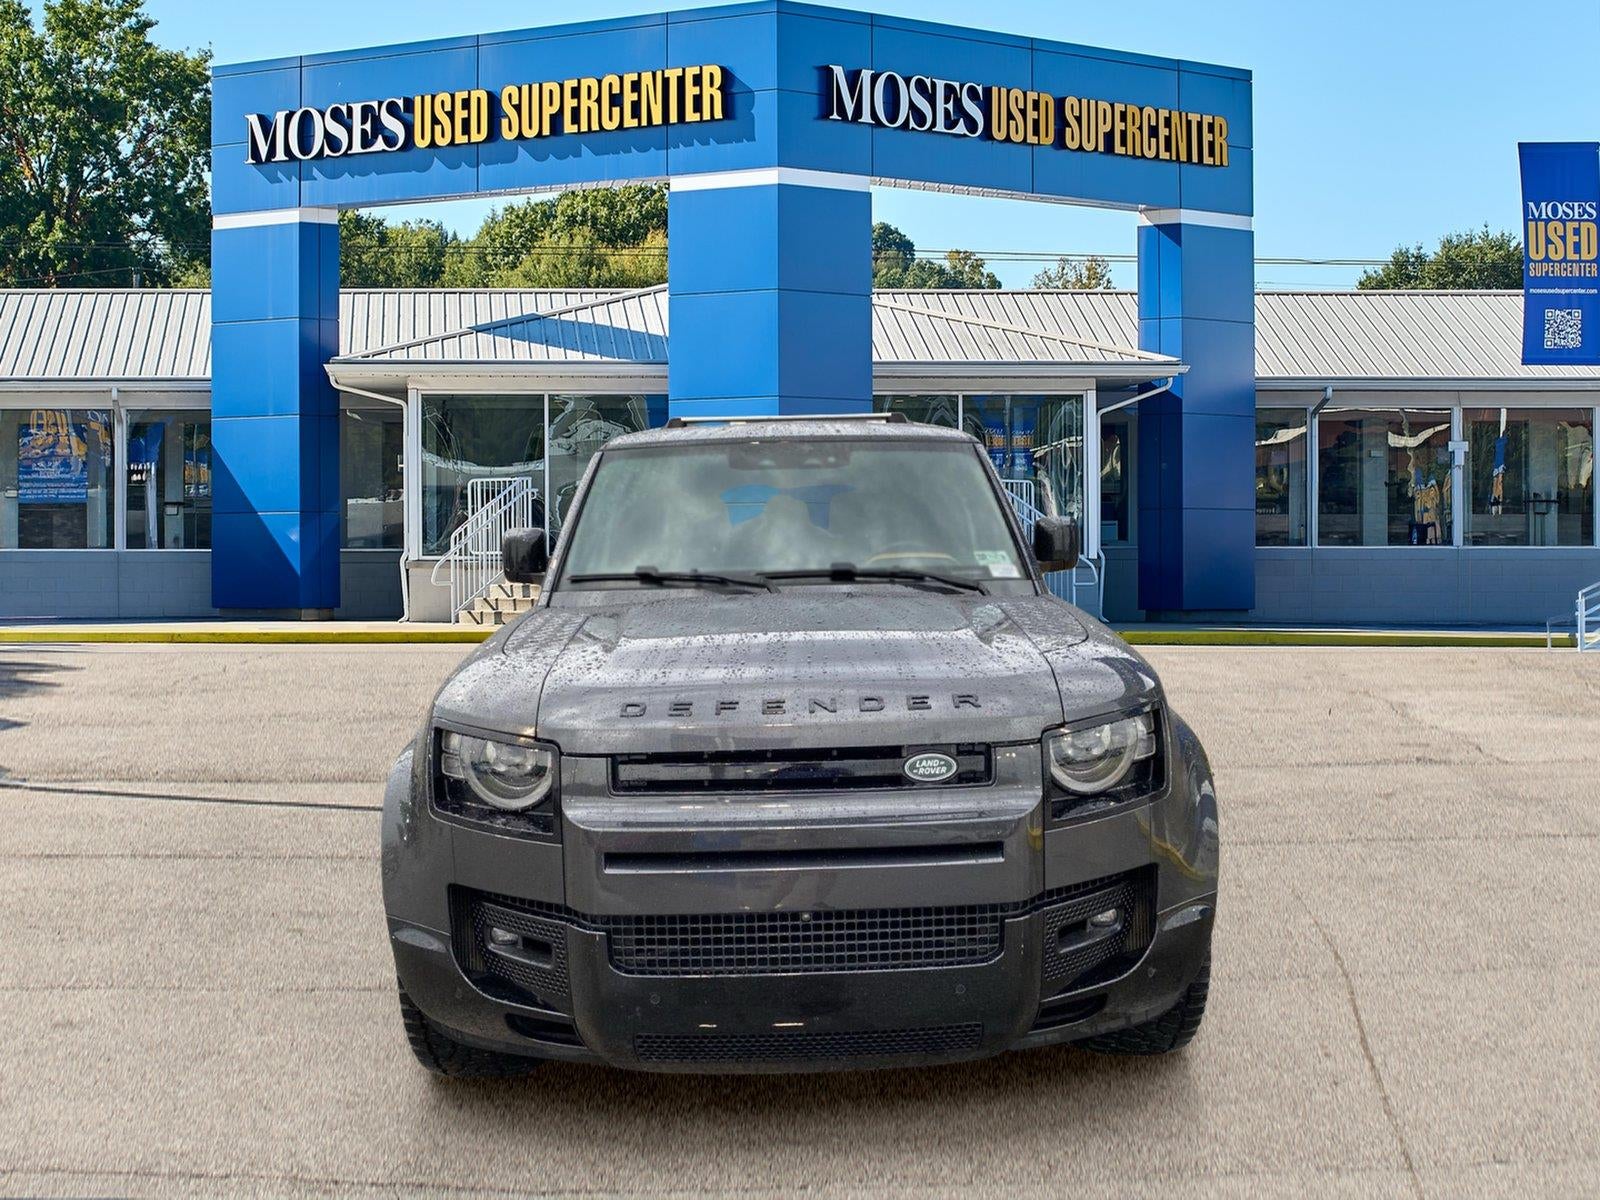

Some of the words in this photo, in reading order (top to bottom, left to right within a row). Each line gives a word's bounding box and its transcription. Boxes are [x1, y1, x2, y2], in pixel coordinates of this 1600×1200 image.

[244, 98, 406, 164] MOSES
[413, 89, 488, 148] USED
[501, 64, 724, 141] SUPERCENTER
[829, 65, 984, 137] MOSES
[991, 86, 1055, 145] USED
[1064, 96, 1229, 166] SUPERCENTER
[1527, 201, 1598, 220] MOSES
[1528, 221, 1598, 261] USED
[1529, 262, 1598, 277] SUPERCENTER
[619, 694, 981, 718] DEFENDER
